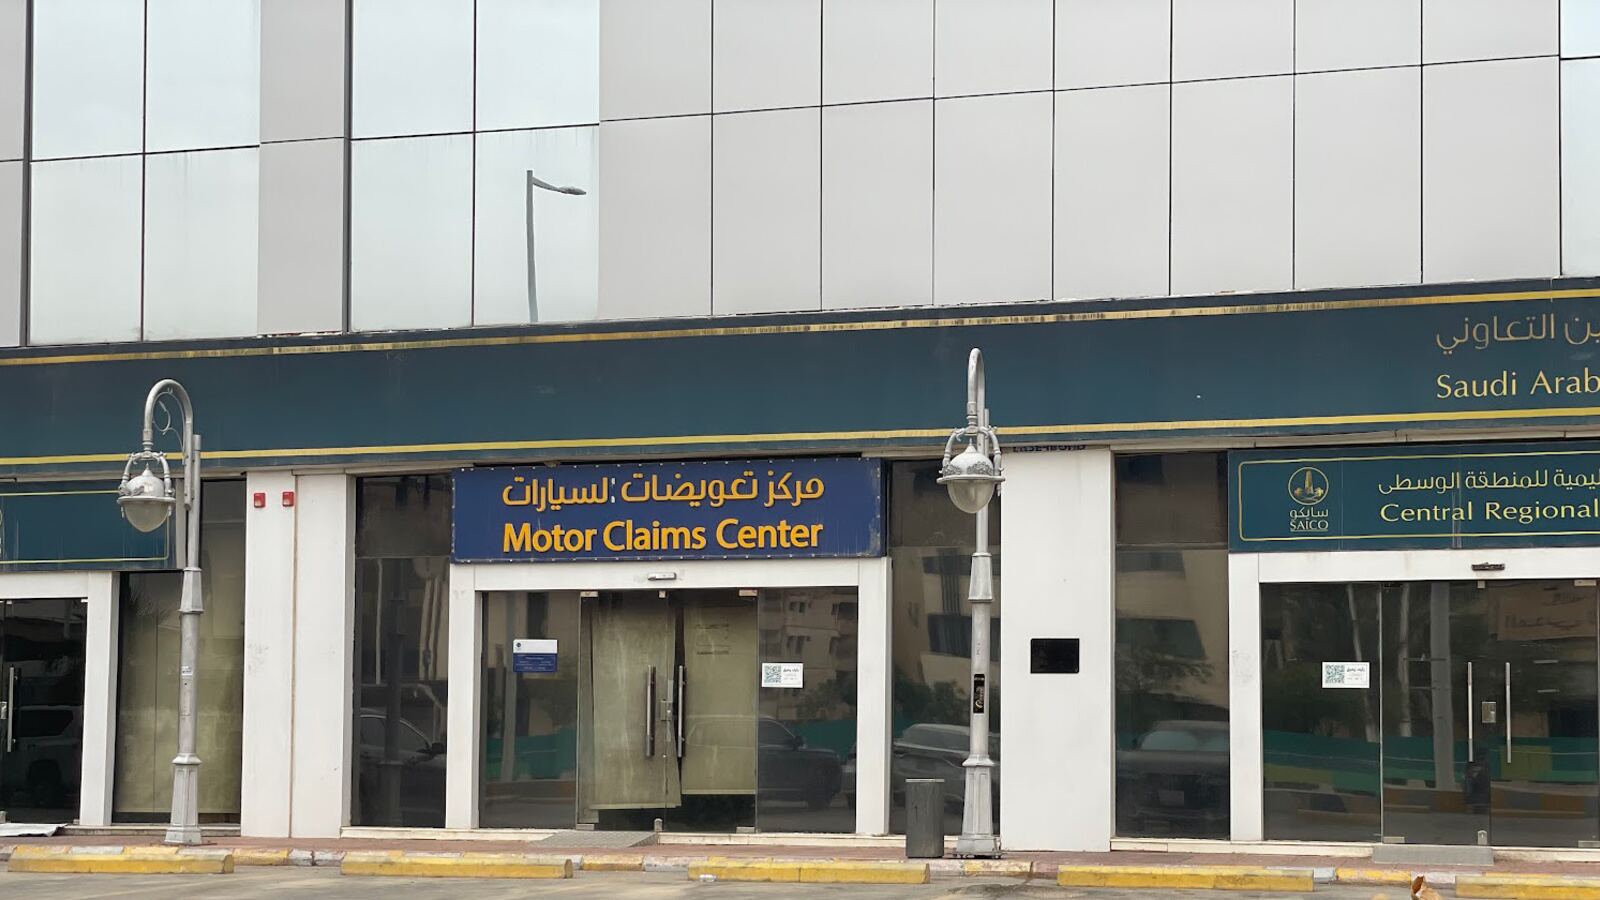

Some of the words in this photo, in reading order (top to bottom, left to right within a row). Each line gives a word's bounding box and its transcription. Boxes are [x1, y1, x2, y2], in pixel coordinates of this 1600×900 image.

[1436, 313, 1555, 355] التعاوني
[1437, 369, 1517, 399] Saudi
[1530, 367, 1600, 395] Arab
[621, 470, 759, 507] تعويضات
[764, 470, 825, 507] مركز
[1378, 471, 1460, 494] الوسطى
[1465, 470, 1548, 489] للمنطقة
[1289, 520, 1329, 530] SAICO
[1380, 501, 1473, 522] Central
[1485, 498, 1599, 524] Regional
[502, 523, 597, 553] Motor
[602, 519, 707, 551] Claims
[715, 518, 823, 549] Center
